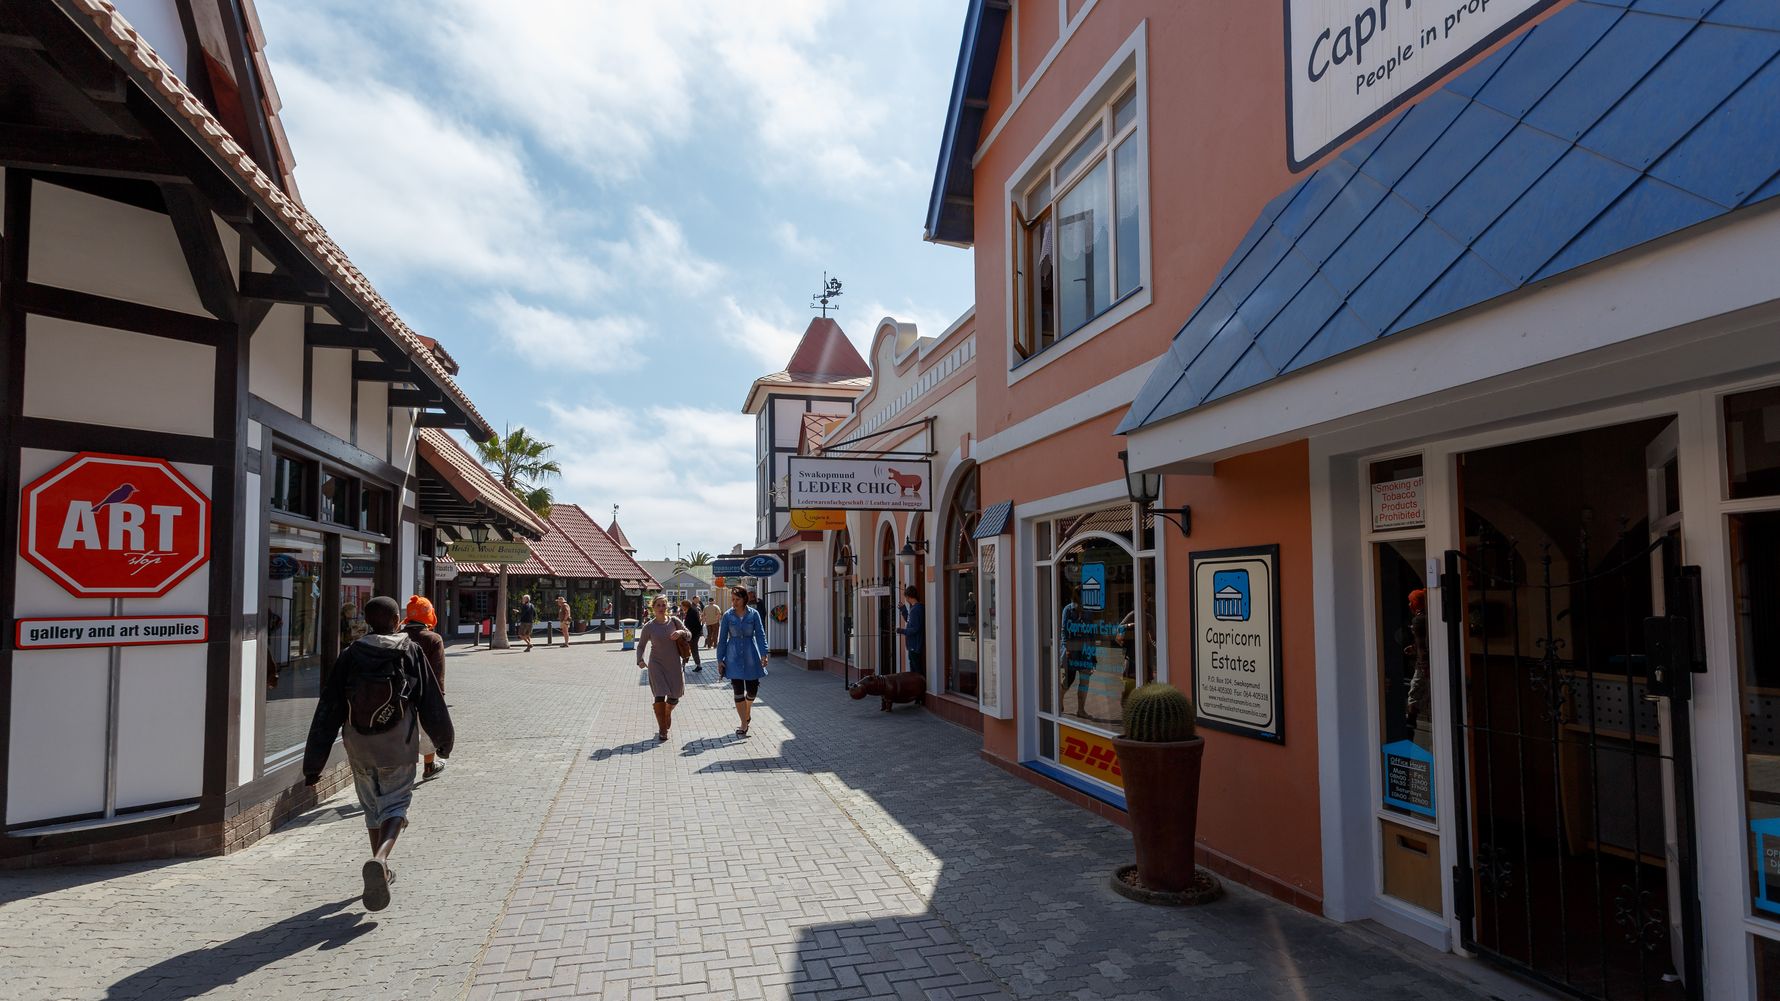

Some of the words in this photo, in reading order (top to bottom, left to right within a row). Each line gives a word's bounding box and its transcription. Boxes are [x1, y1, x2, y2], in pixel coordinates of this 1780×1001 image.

[1420, 29, 1437, 48] in
[798, 470, 855, 480] Swakopmund
[798, 480, 852, 494] LEDER
[857, 482, 897, 494] CHIC
[1376, 482, 1410, 492] Smoking
[1382, 491, 1415, 501] Tobacco
[1382, 501, 1417, 511] Products
[1379, 509, 1420, 521] Prohibited
[57, 499, 183, 552] ART
[478, 545, 496, 553] Wool
[30, 625, 84, 642] gallery
[88, 623, 115, 638] and
[119, 623, 140, 637] art
[143, 622, 200, 638] supplies
[1206, 627, 1261, 650] Capricorn
[1211, 651, 1257, 673] Estates
[1234, 679, 1261, 690] Swakopmund
[1390, 756, 1408, 767] Office
